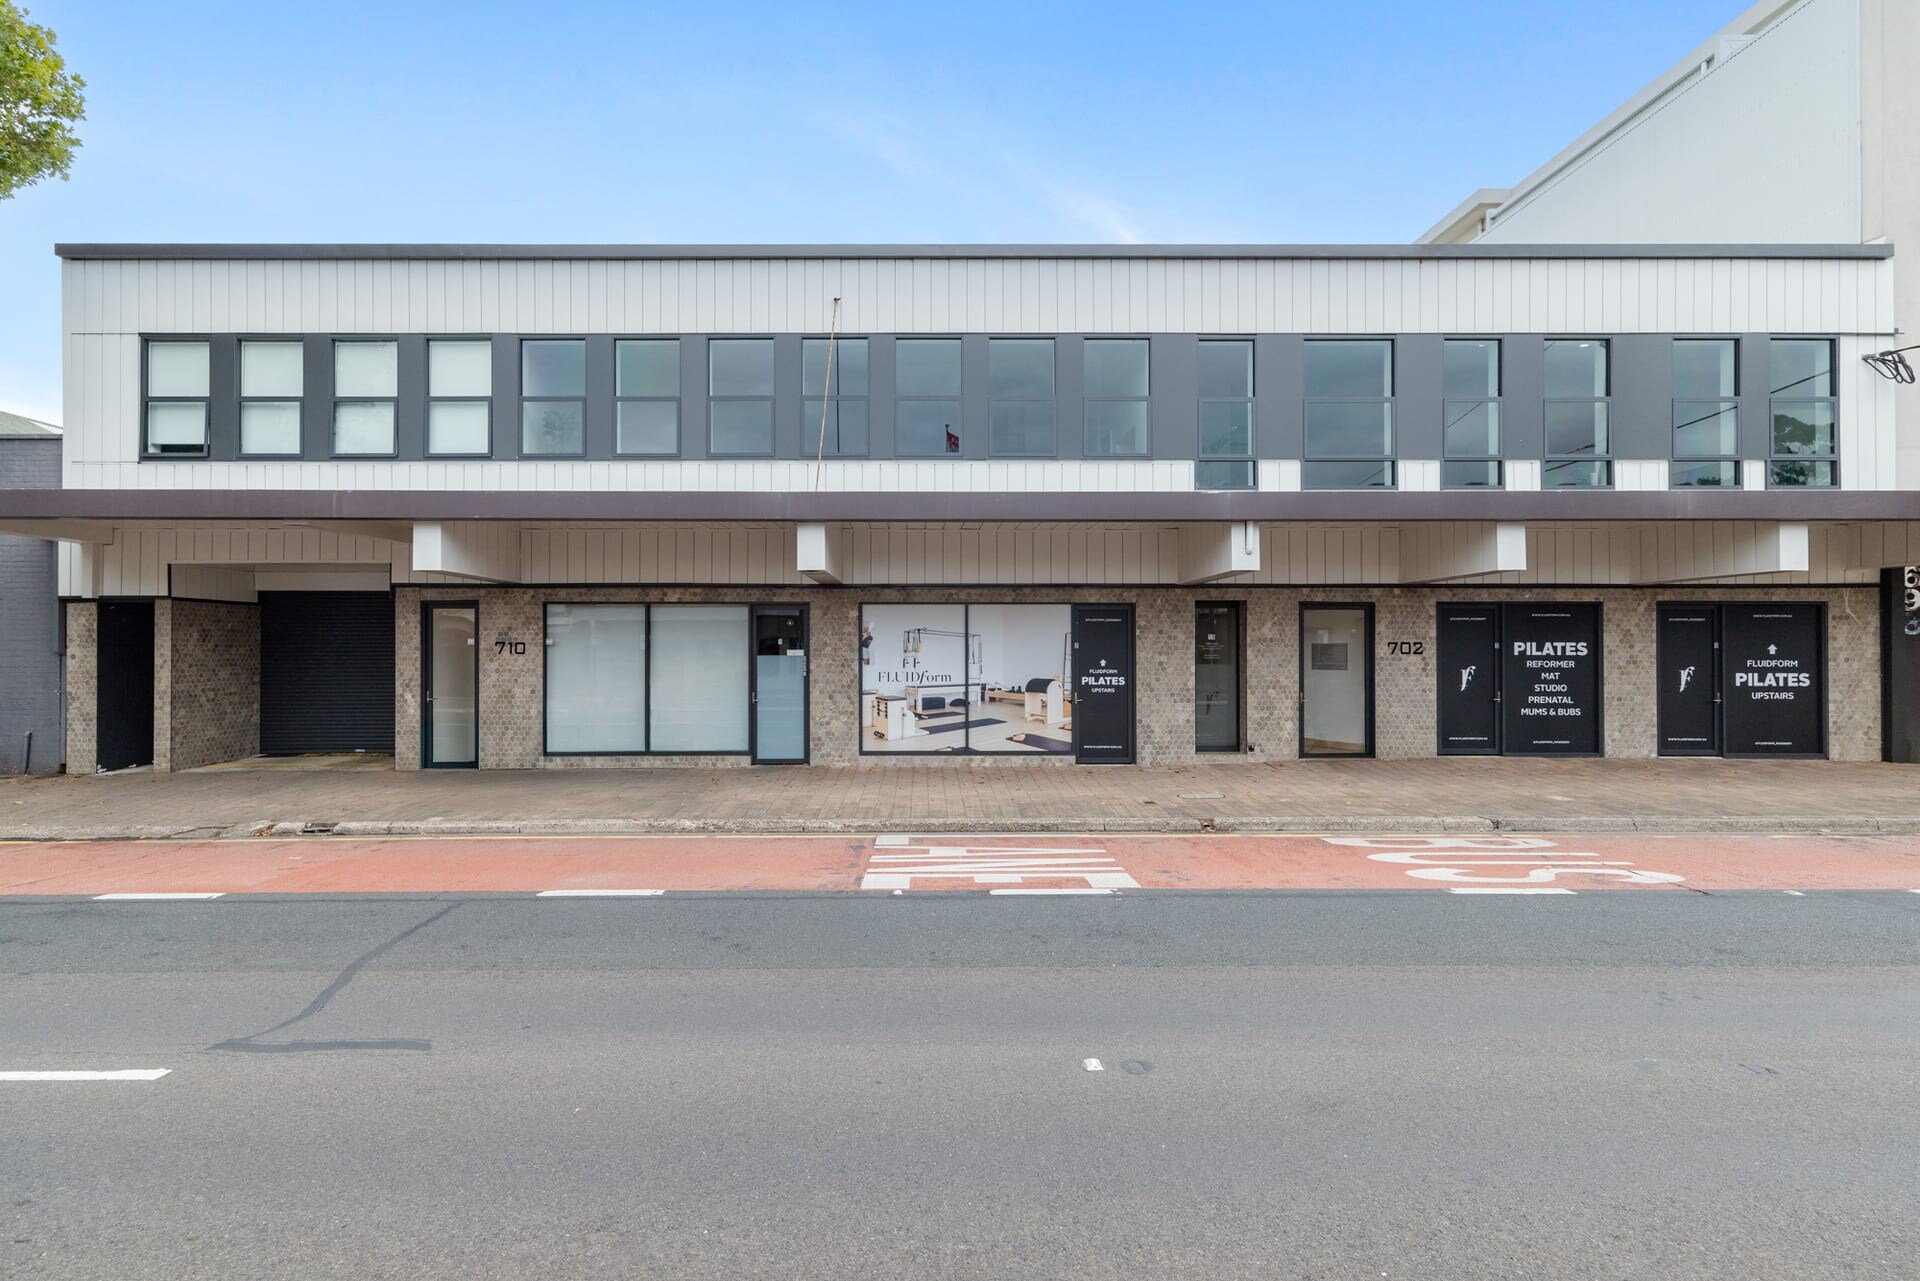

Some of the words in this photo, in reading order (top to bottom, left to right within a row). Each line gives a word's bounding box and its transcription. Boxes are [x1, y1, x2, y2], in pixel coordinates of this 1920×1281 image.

[495, 642, 526, 655] 710
[1387, 642, 1424, 655] 702
[1513, 641, 1588, 656] PILATES
[1526, 660, 1576, 669] REFORMER
[1746, 659, 1799, 668] FLUIDFORM
[878, 670, 952, 685] FLUIDform
[1541, 672, 1561, 680] MAT
[1735, 672, 1811, 687] PILATES
[1081, 676, 1126, 686] PILATES
[1534, 683, 1568, 692] STUDIO
[1528, 695, 1574, 704] PRENATAL
[1751, 691, 1795, 700] UPSTAIRS
[1520, 707, 1548, 716] MUMS
[1548, 707, 1556, 716] &
[1557, 707, 1582, 716] BUBS
